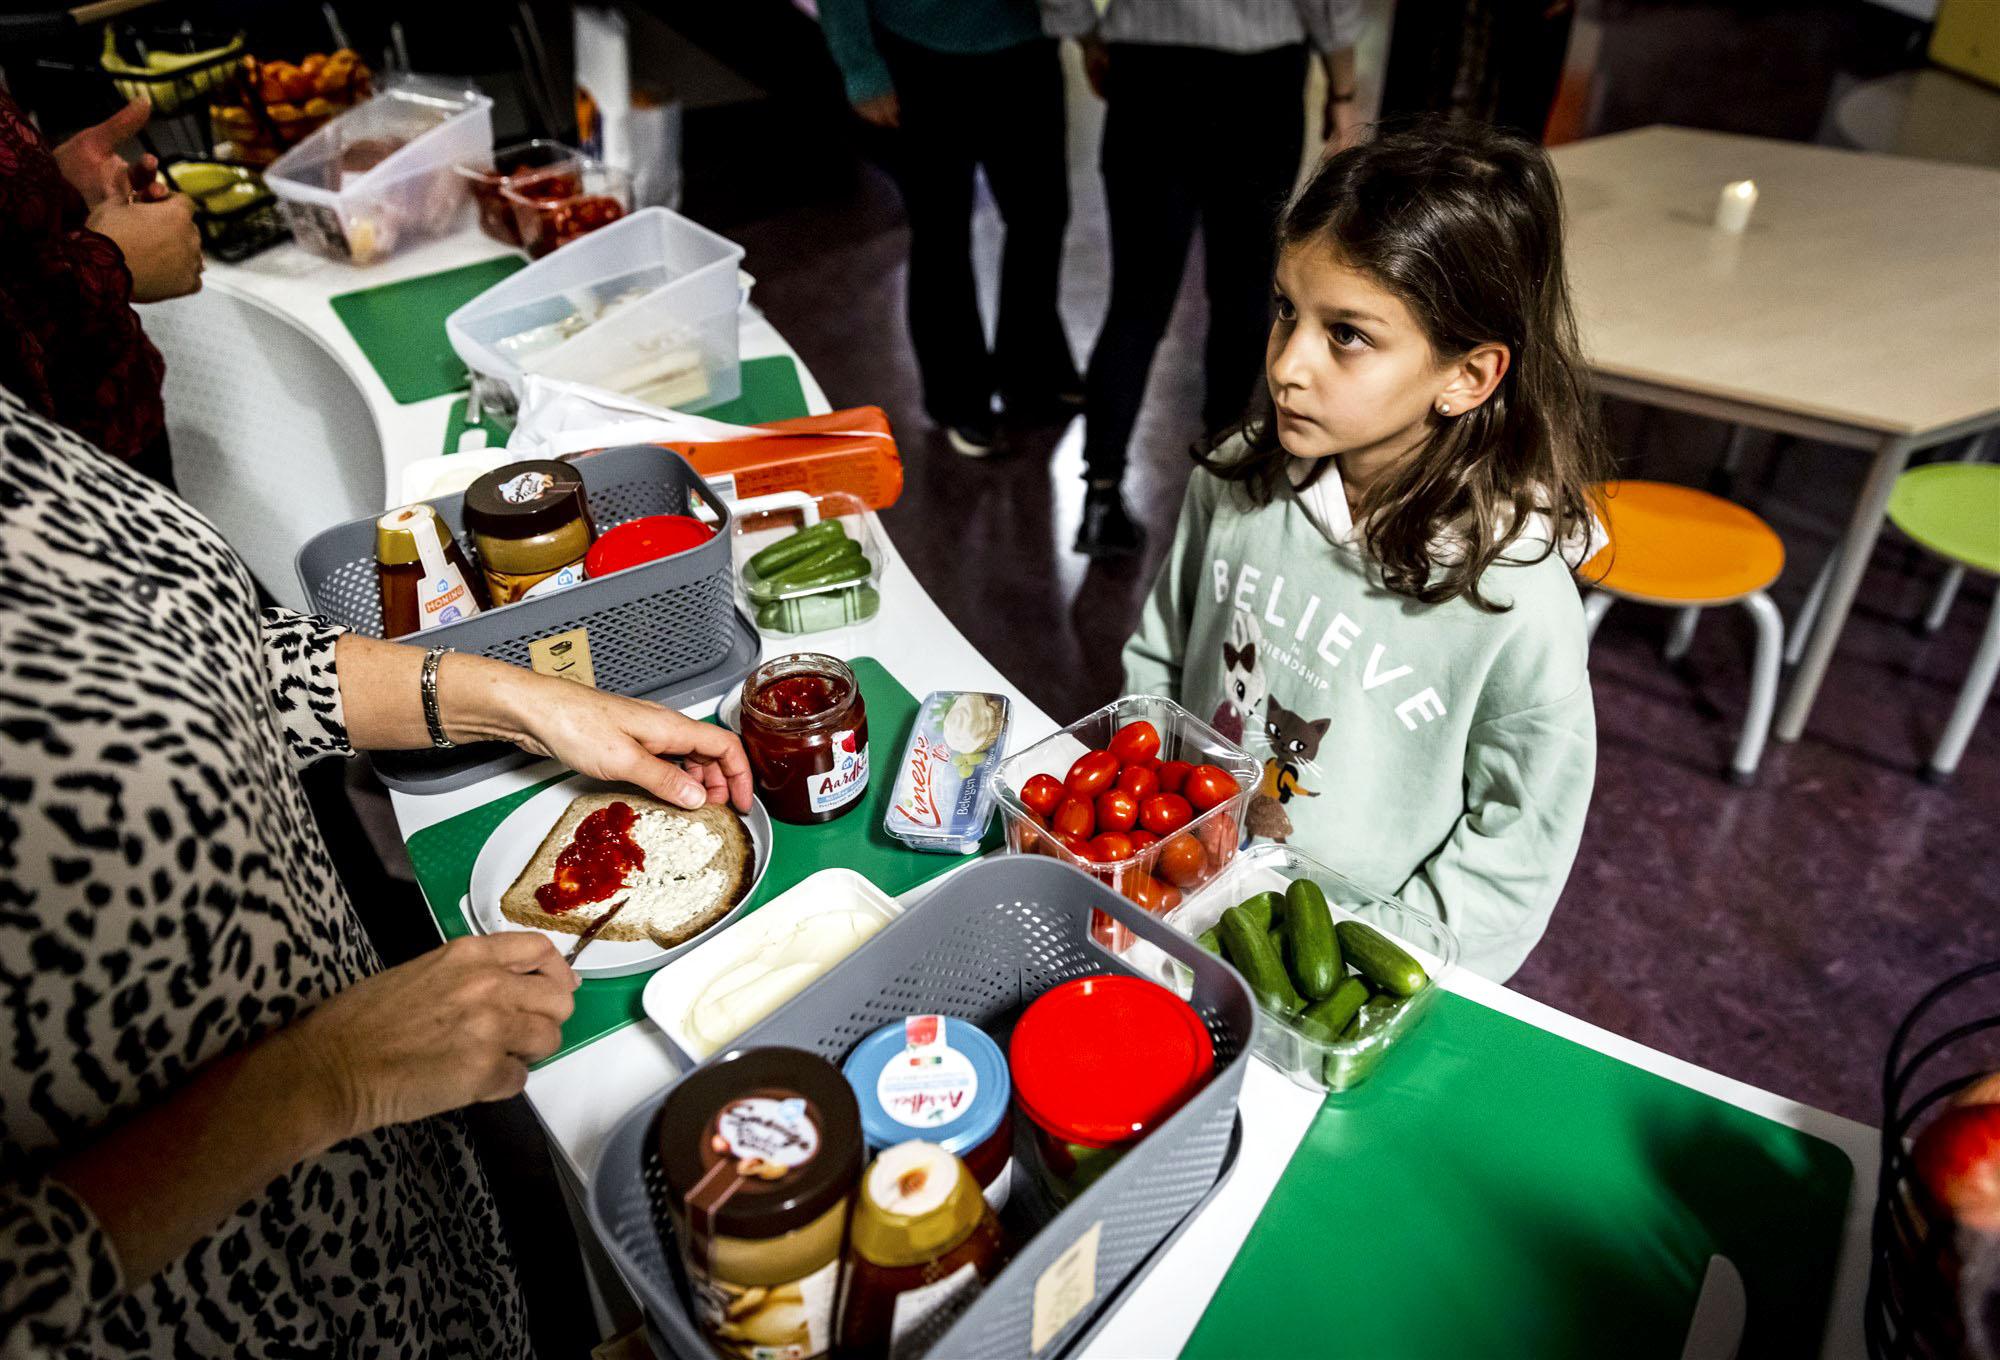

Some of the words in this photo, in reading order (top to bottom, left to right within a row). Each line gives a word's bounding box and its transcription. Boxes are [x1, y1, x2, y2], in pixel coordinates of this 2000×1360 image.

[426, 584, 464, 612] HONING
[1213, 559, 1447, 731] BELIEVE
[957, 778, 977, 815] Belegen
